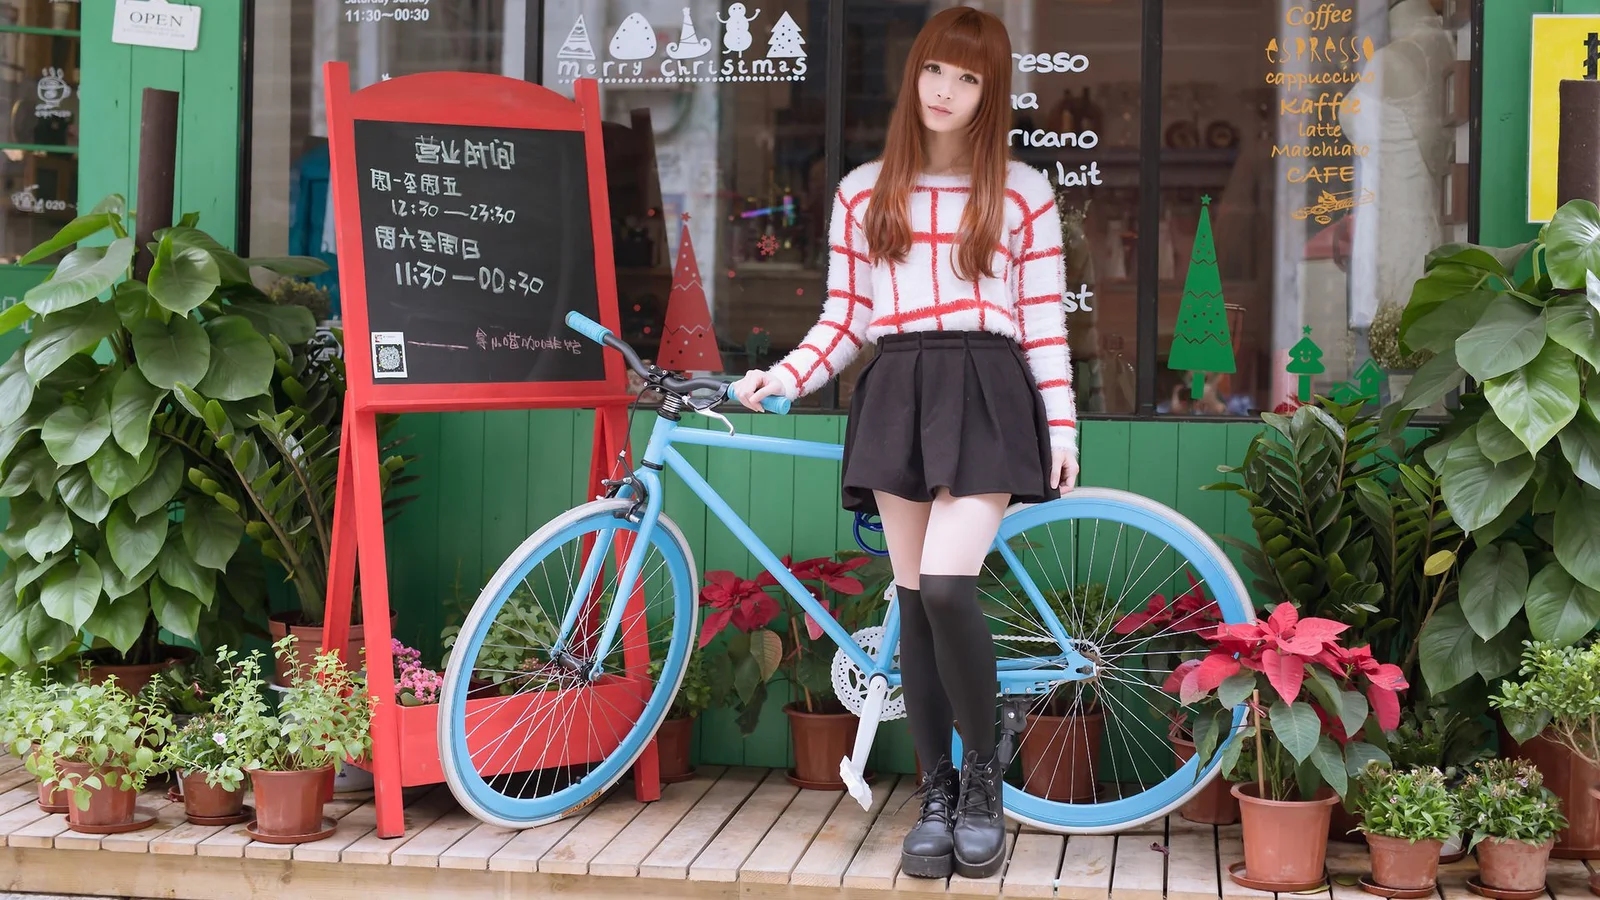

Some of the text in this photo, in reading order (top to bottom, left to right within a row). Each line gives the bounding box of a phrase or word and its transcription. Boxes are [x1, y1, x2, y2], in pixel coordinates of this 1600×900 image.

[129, 11, 183, 27] OPEN
[1286, 3, 1353, 30] Coffee
[1265, 65, 1375, 92] cappuccino
[1007, 128, 1099, 149] ricano
[1298, 121, 1342, 137] latte
[415, 135, 515, 170] 营业时间
[1271, 139, 1370, 158] Macchiato
[370, 168, 462, 196] 周一至周五
[1056, 160, 1103, 187] lait
[1287, 166, 1355, 184] CAFE
[375, 225, 481, 260] 周六至周日
[1061, 283, 1094, 313] st
